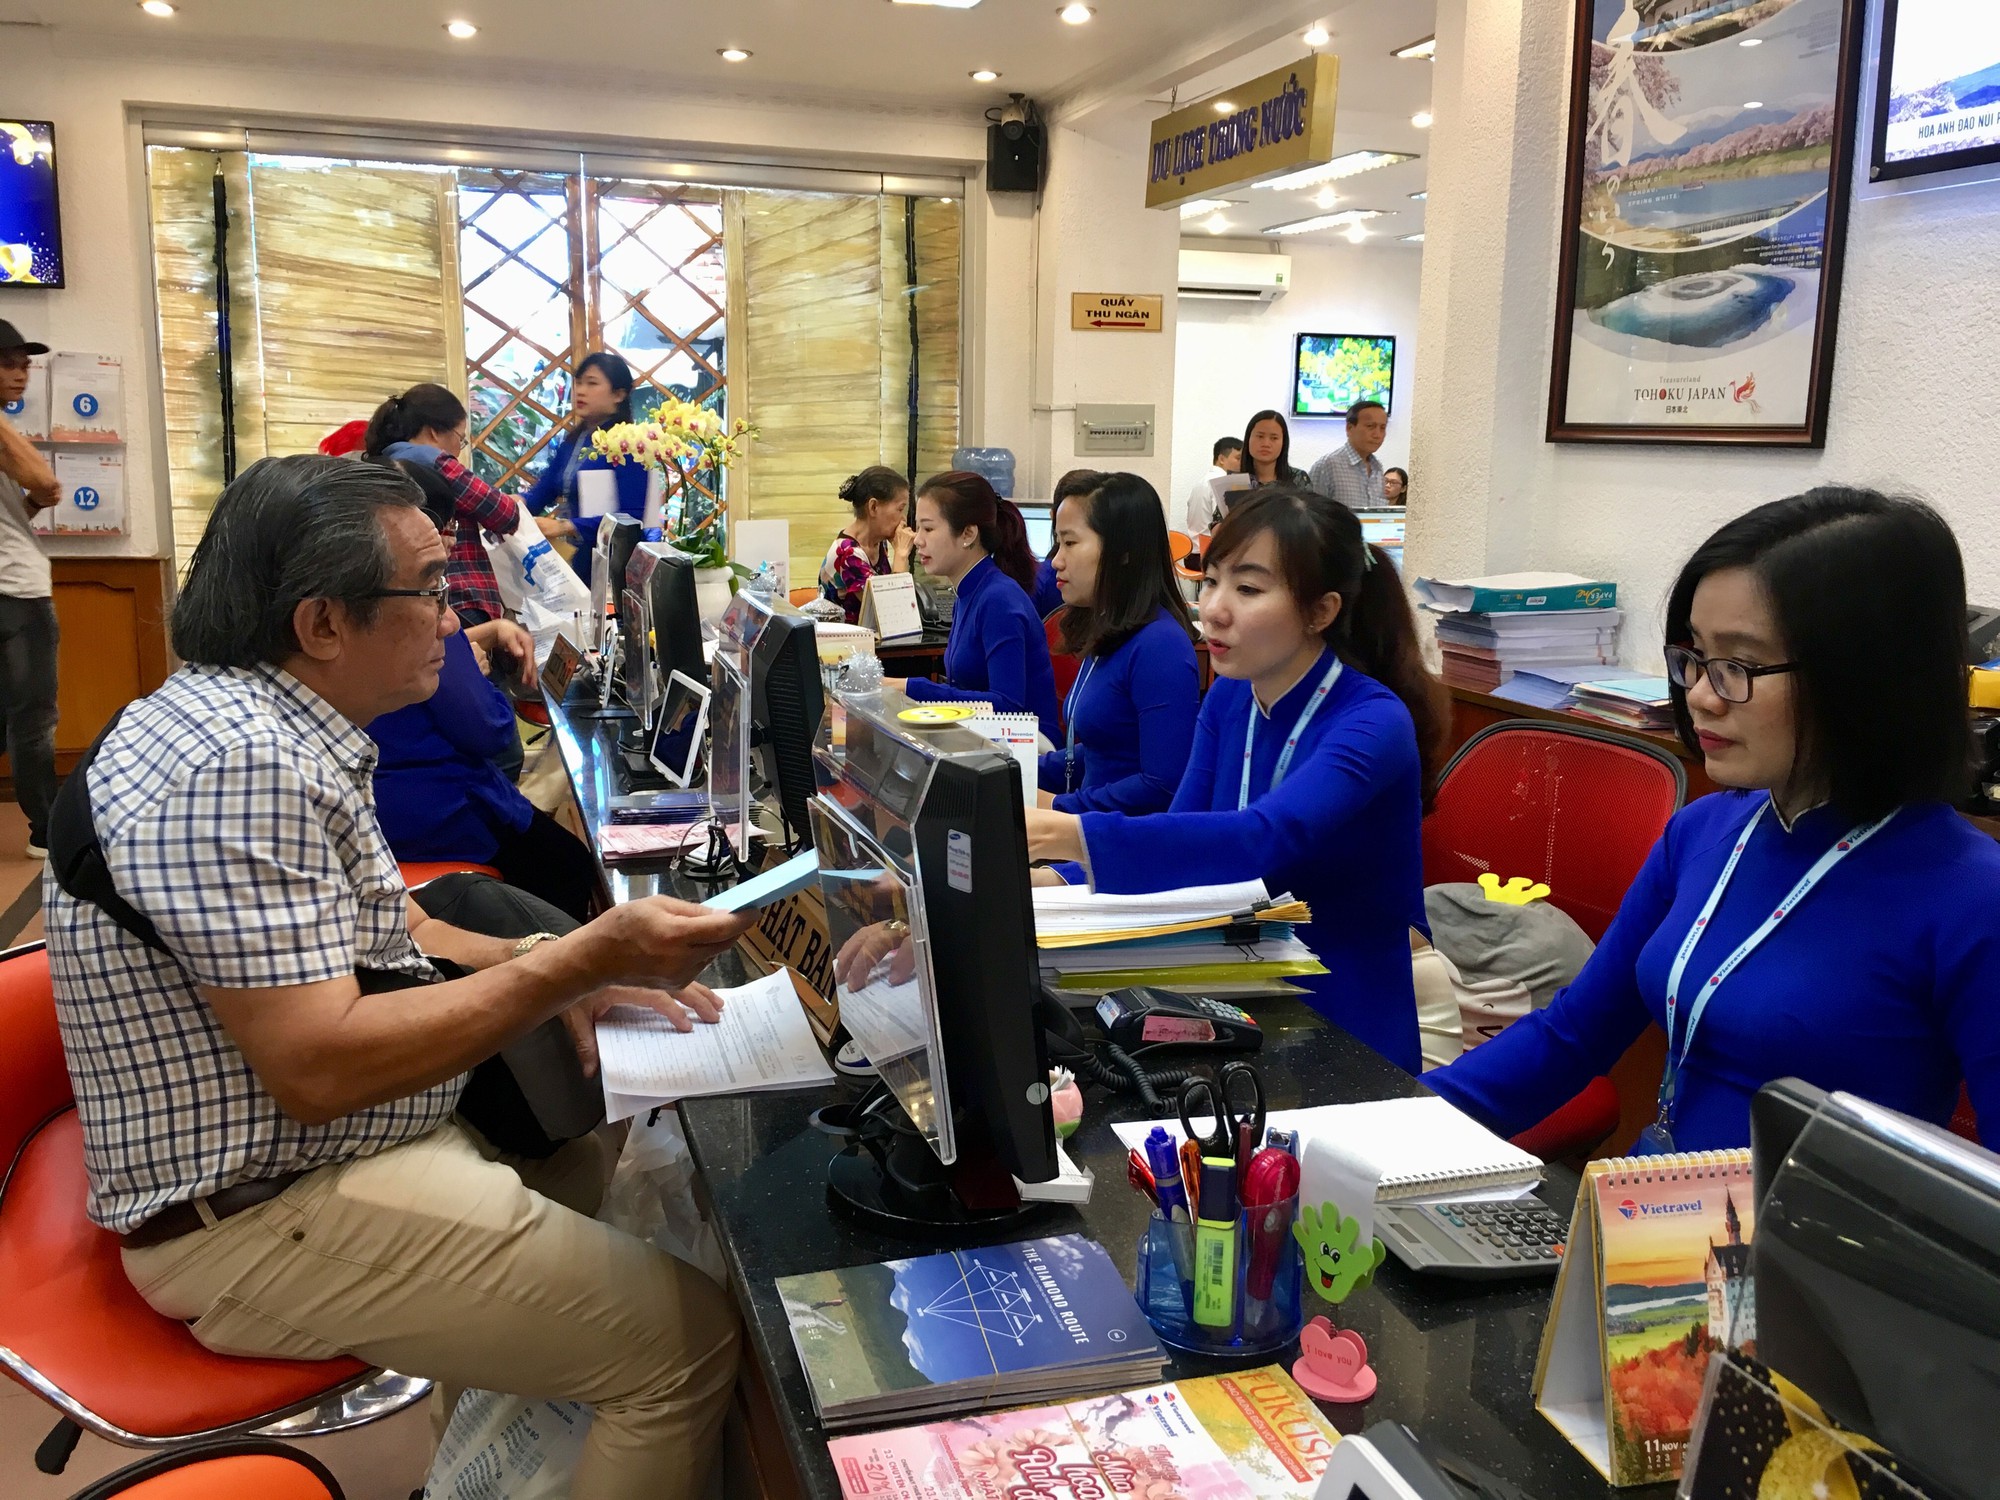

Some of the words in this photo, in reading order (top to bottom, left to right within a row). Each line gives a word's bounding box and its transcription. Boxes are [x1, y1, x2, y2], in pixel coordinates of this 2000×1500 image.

[1918, 124, 1935, 139] HOA
[1937, 120, 1955, 135] ANH
[1152, 138, 1172, 183] DU
[1173, 125, 1207, 185] LỊCH
[1208, 106, 1258, 165] TRONG
[1629, 178, 1651, 187] COLOR
[1628, 198, 1653, 207] SPRING
[1085, 310, 1111, 318] THU
[1115, 310, 1150, 319] NGÂN
[1659, 375, 1701, 384] Treasureland
[1634, 387, 1684, 401] TOHOKU
[1687, 387, 1727, 401] JAPAN
[79, 397, 92, 413] 6
[77, 490, 95, 506] 12
[1001, 728, 1011, 736] 11
[1781, 879, 1811, 911] Vietravel
[1717, 946, 1747, 978] Vietravel
[1640, 1200, 1702, 1215] Vietravel
[1022, 1248, 1042, 1264] THE
[1033, 1265, 1069, 1308] DIAMOND
[1059, 1310, 1090, 1345] ROUTE
[1307, 1344, 1310, 1353] I
[1314, 1348, 1333, 1360] love
[1336, 1355, 1352, 1366] you
[1152, 1404, 1179, 1438] Vietravel
[1169, 1402, 1195, 1435] Vietravel
[884, 1449, 894, 1459] 23
[1644, 1439, 1660, 1453] 11
[1661, 1442, 1679, 1451] NOV
[940, 1434, 958, 1460] Diamond
[953, 1461, 965, 1479] Route
[961, 1480, 974, 1498] Japan
[1012, 1446, 1069, 1490] Anh
[1271, 1439, 1306, 1480] FUKUSHIMA
[1655, 1454, 1661, 1463] 2
[1664, 1453, 1670, 1462] 3
[864, 1463, 893, 1492] 30%
[1060, 1464, 1104, 1500] hoa
[1094, 1452, 1137, 1493] Mùa
